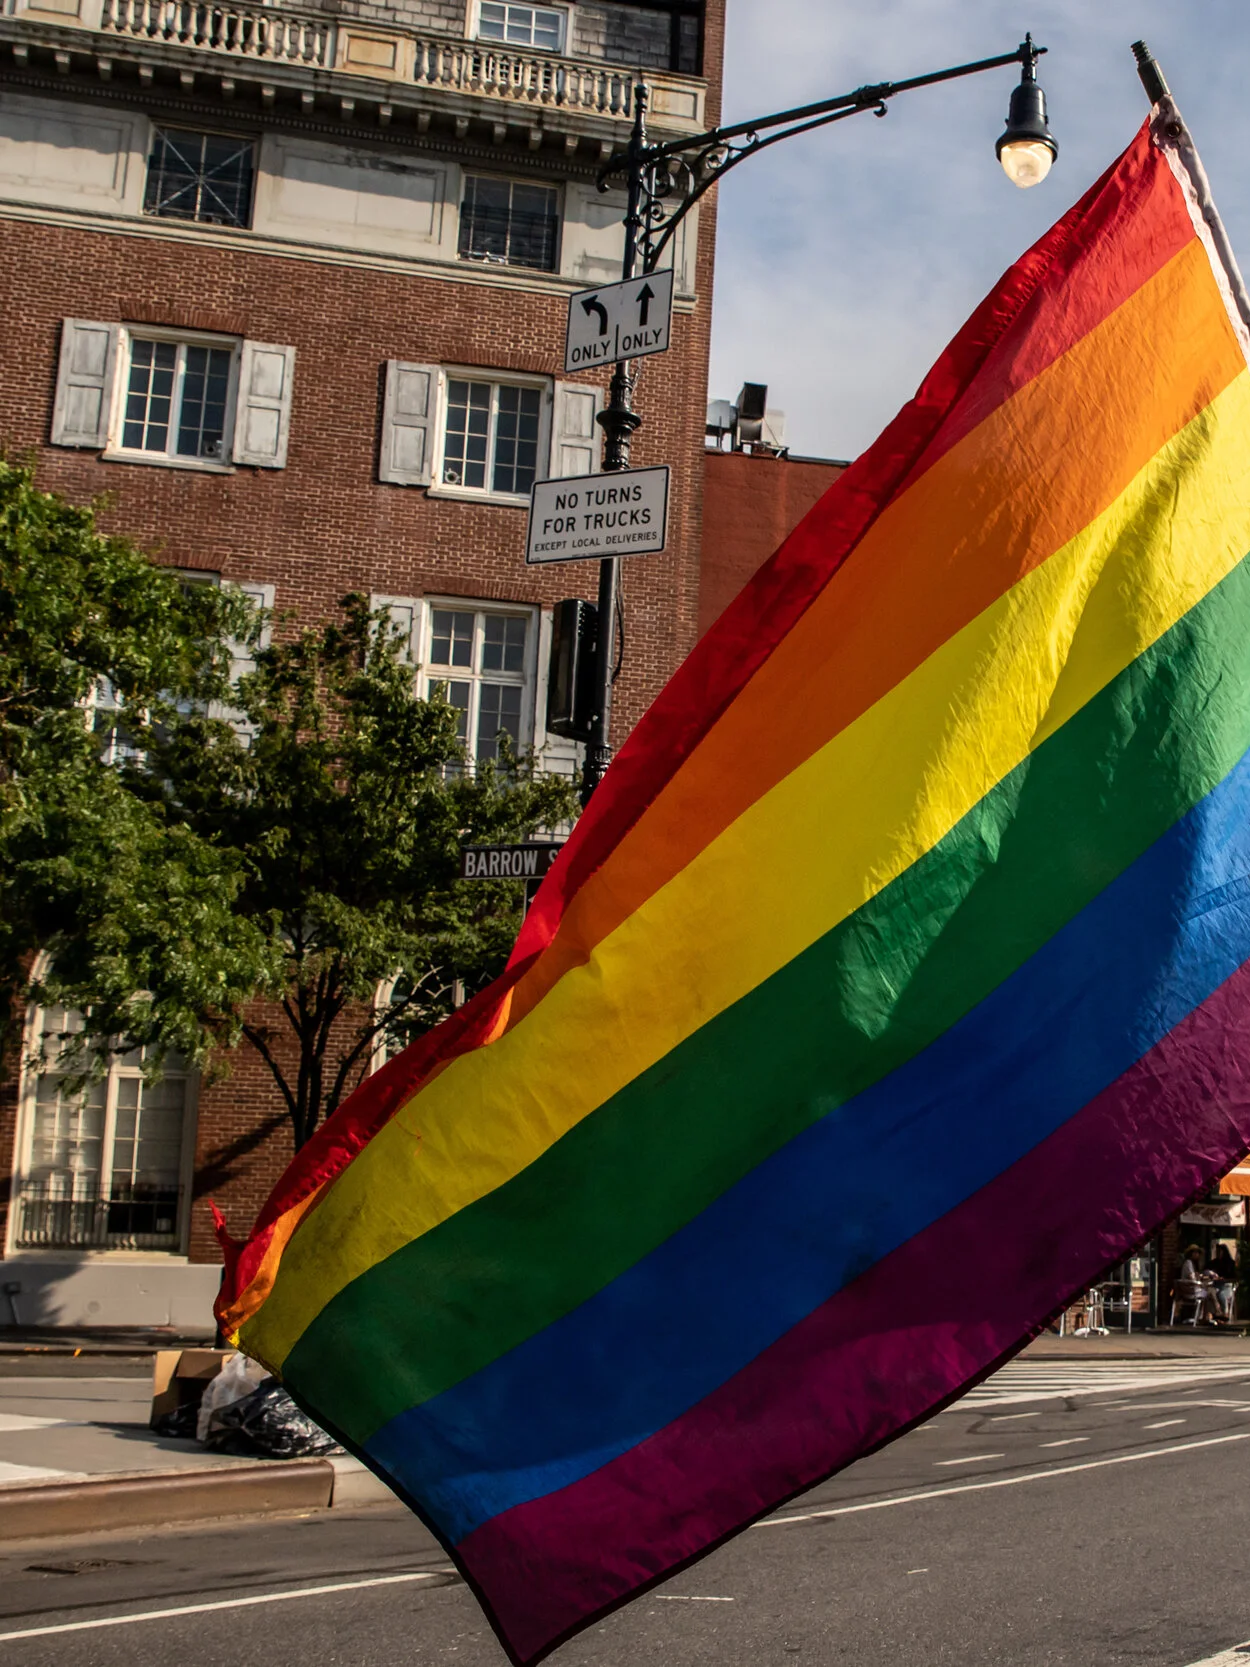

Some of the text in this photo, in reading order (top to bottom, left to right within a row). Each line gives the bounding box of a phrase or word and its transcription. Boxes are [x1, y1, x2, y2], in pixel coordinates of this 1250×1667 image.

[571, 340, 611, 363] ONLY
[622, 328, 662, 351] ONLY
[555, 485, 642, 510] NO TURNS
[543, 508, 651, 535] FOR TRUCKS
[534, 531, 657, 553] EXCEPT LOCAL DELIVERIES
[465, 850, 538, 876] BARROW
